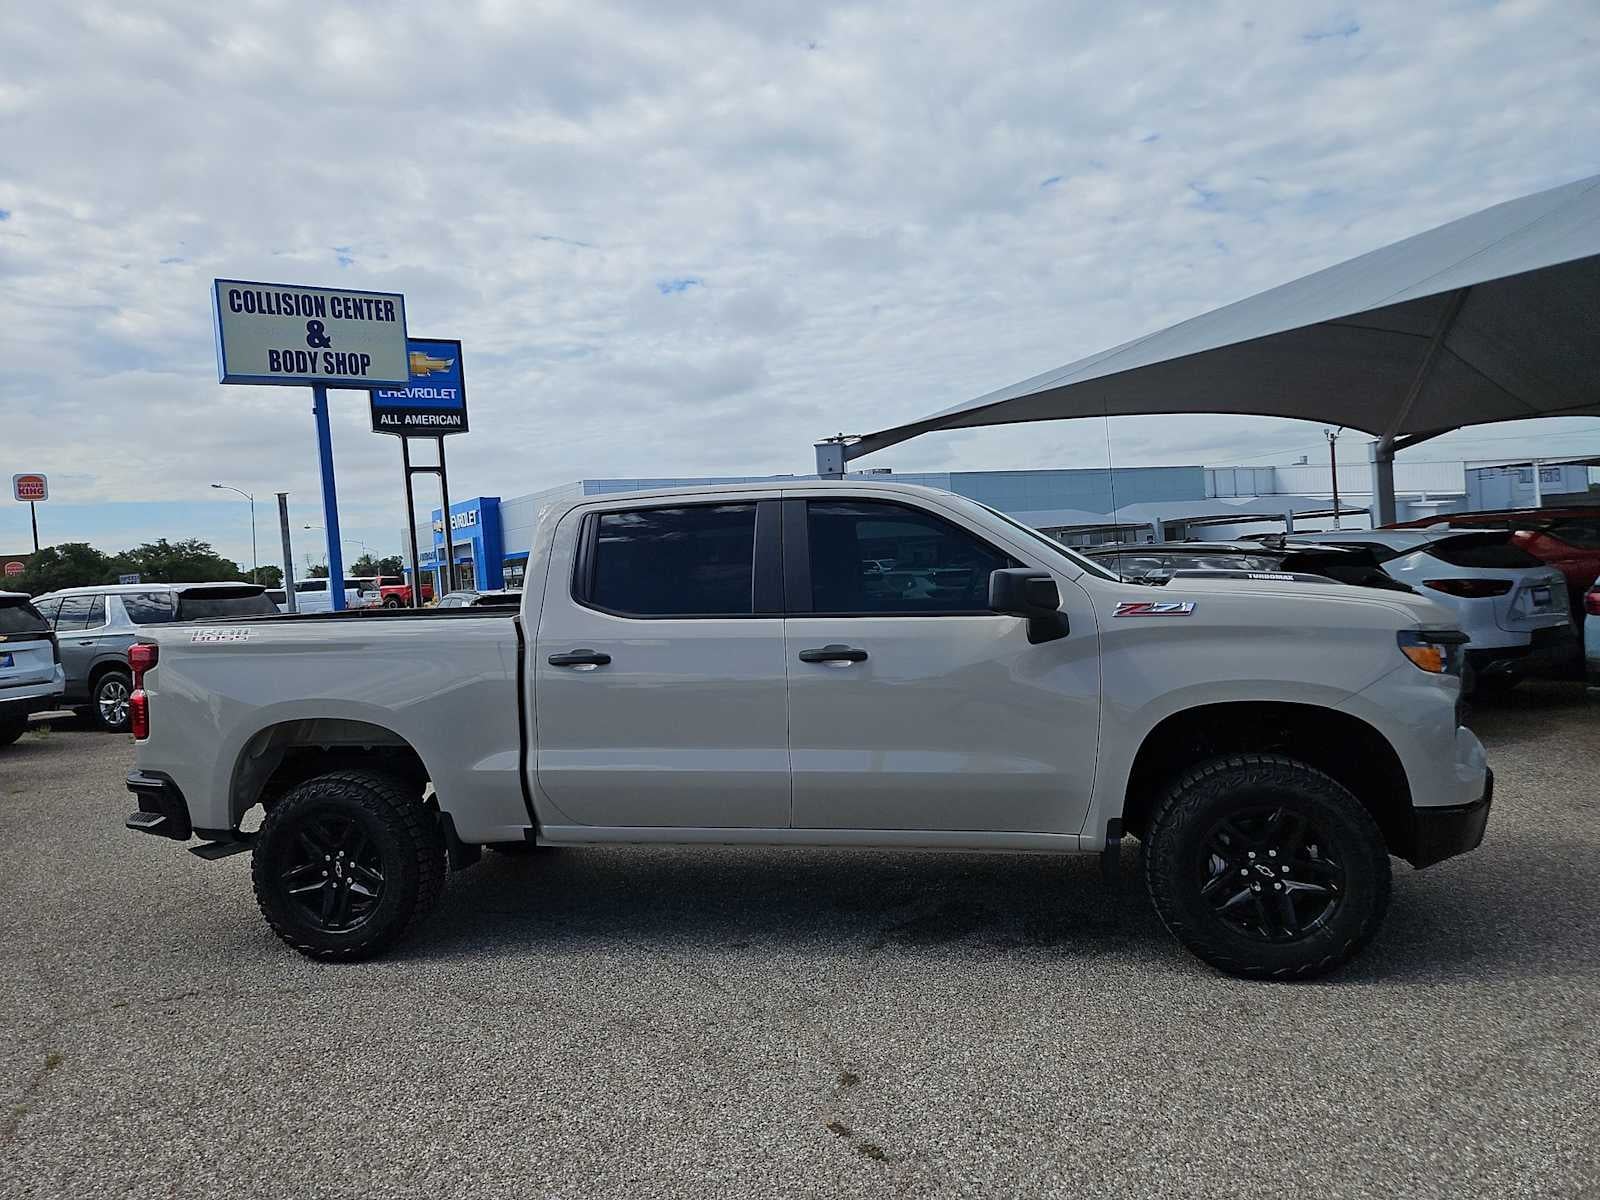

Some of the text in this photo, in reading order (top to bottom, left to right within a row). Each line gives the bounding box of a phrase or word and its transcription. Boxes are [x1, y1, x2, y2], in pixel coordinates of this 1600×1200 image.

[228, 288, 396, 322] COLLISION CENTER
[306, 319, 331, 349] &
[268, 349, 371, 376] BODY SHOP
[380, 414, 461, 425] ALL AMERICAN
[18, 487, 45, 495] KING
[450, 510, 477, 530] EVROLET
[1112, 602, 1196, 617] Z71
